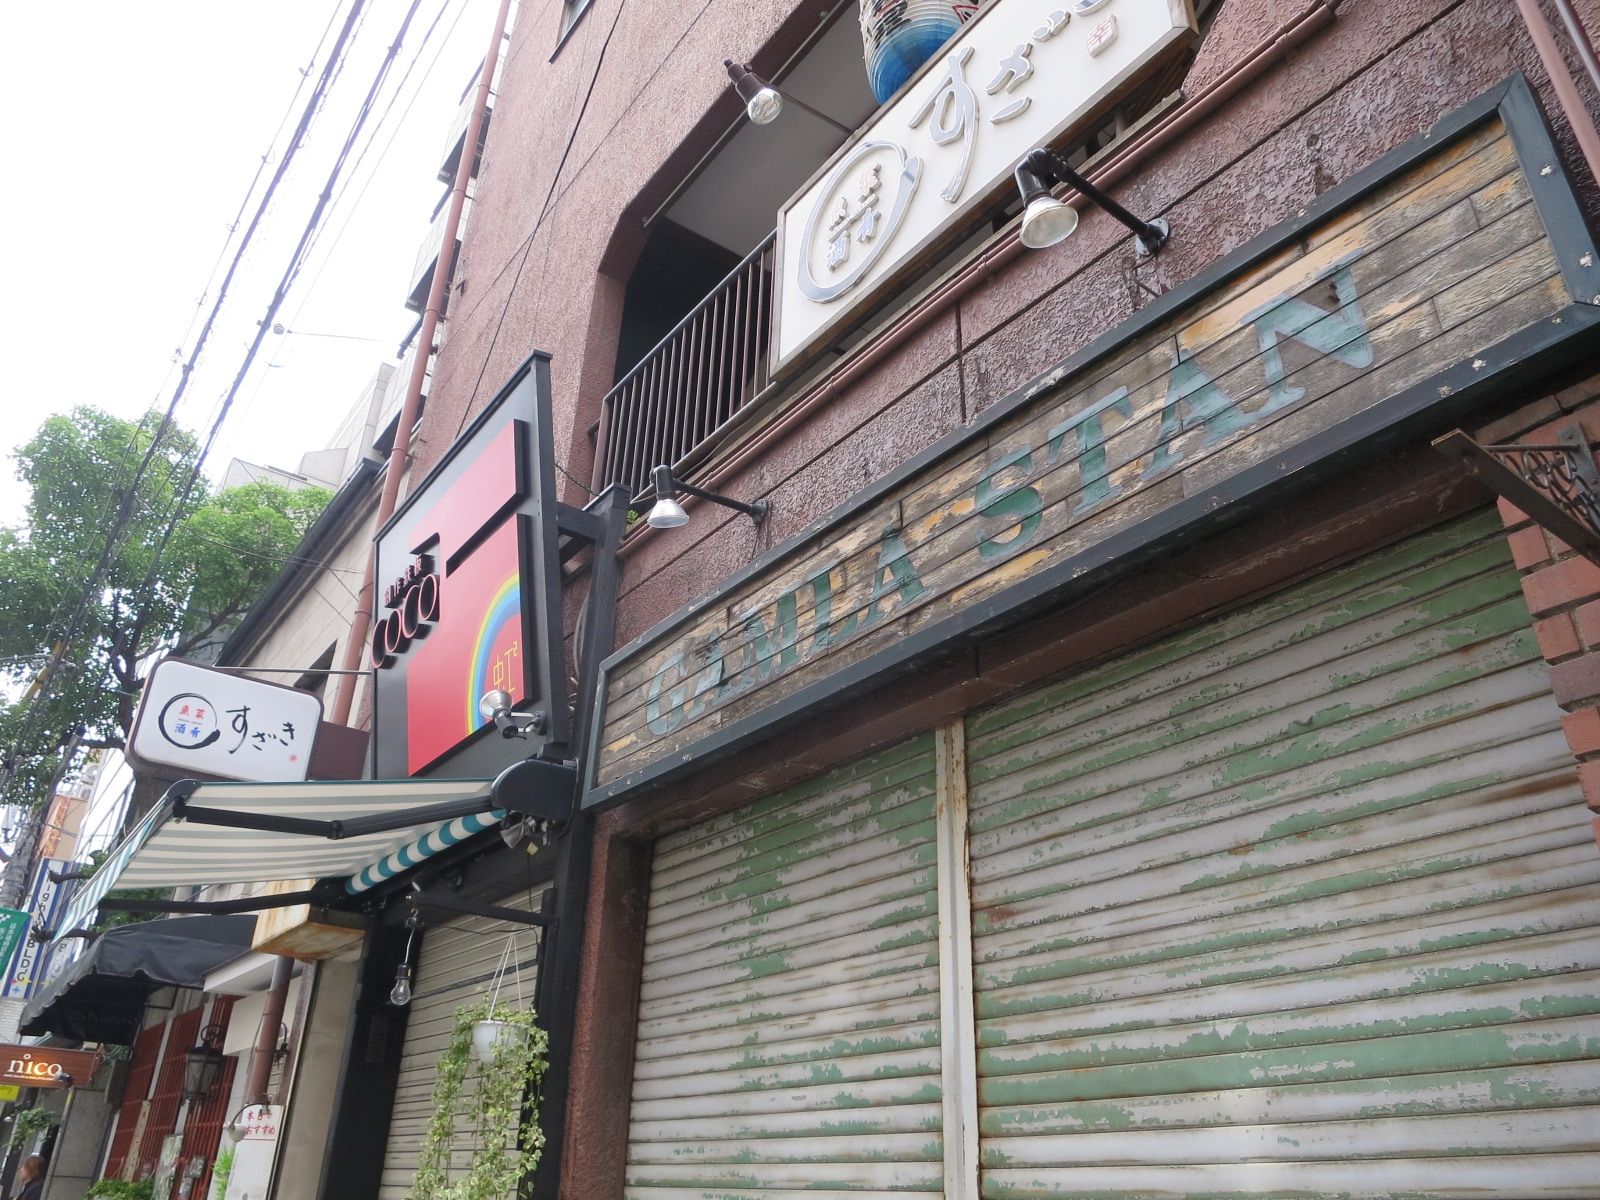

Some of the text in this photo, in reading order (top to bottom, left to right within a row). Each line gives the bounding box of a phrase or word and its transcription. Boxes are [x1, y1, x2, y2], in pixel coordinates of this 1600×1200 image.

[646, 248, 1374, 736] GAMLA STAN
[226, 705, 295, 754] すざき
[7, 1053, 63, 1077] nico
